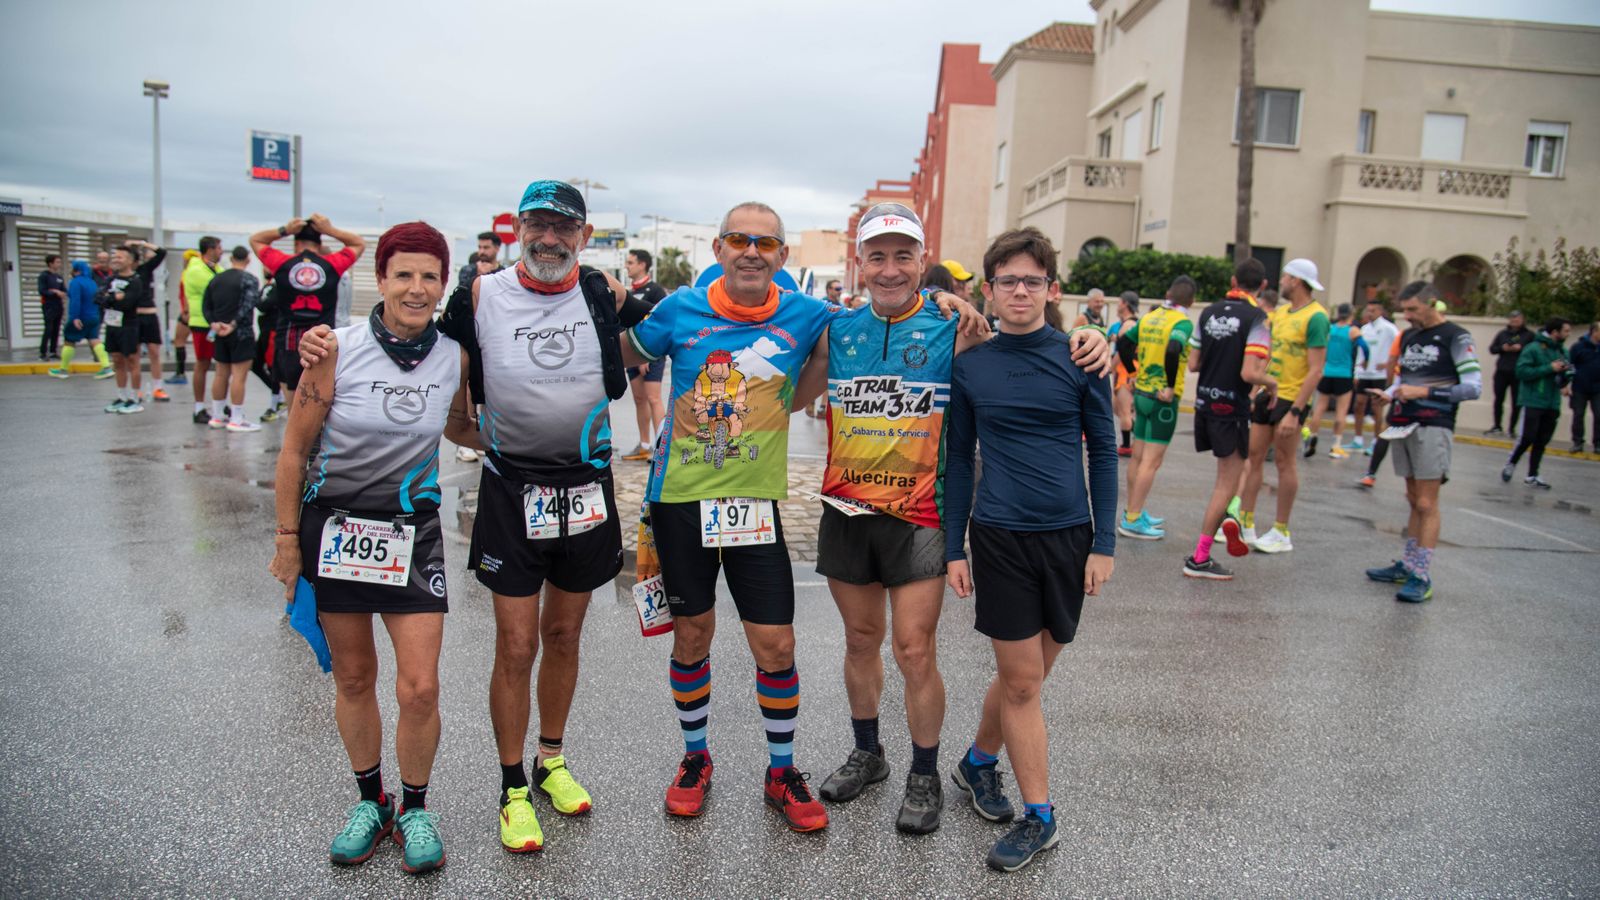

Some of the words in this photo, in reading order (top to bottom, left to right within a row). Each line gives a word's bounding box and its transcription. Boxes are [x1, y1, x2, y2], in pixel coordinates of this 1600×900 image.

[263, 140, 279, 160] P
[837, 386, 852, 398] C.D.
[854, 379, 899, 397] TRAIL
[843, 399, 887, 414] TEAM
[851, 426, 886, 437] Gabarras
[888, 428, 894, 436] &
[897, 428, 930, 438] Servicios
[726, 504, 750, 527] 97
[339, 521, 368, 535] XIV
[342, 534, 389, 563] 495
